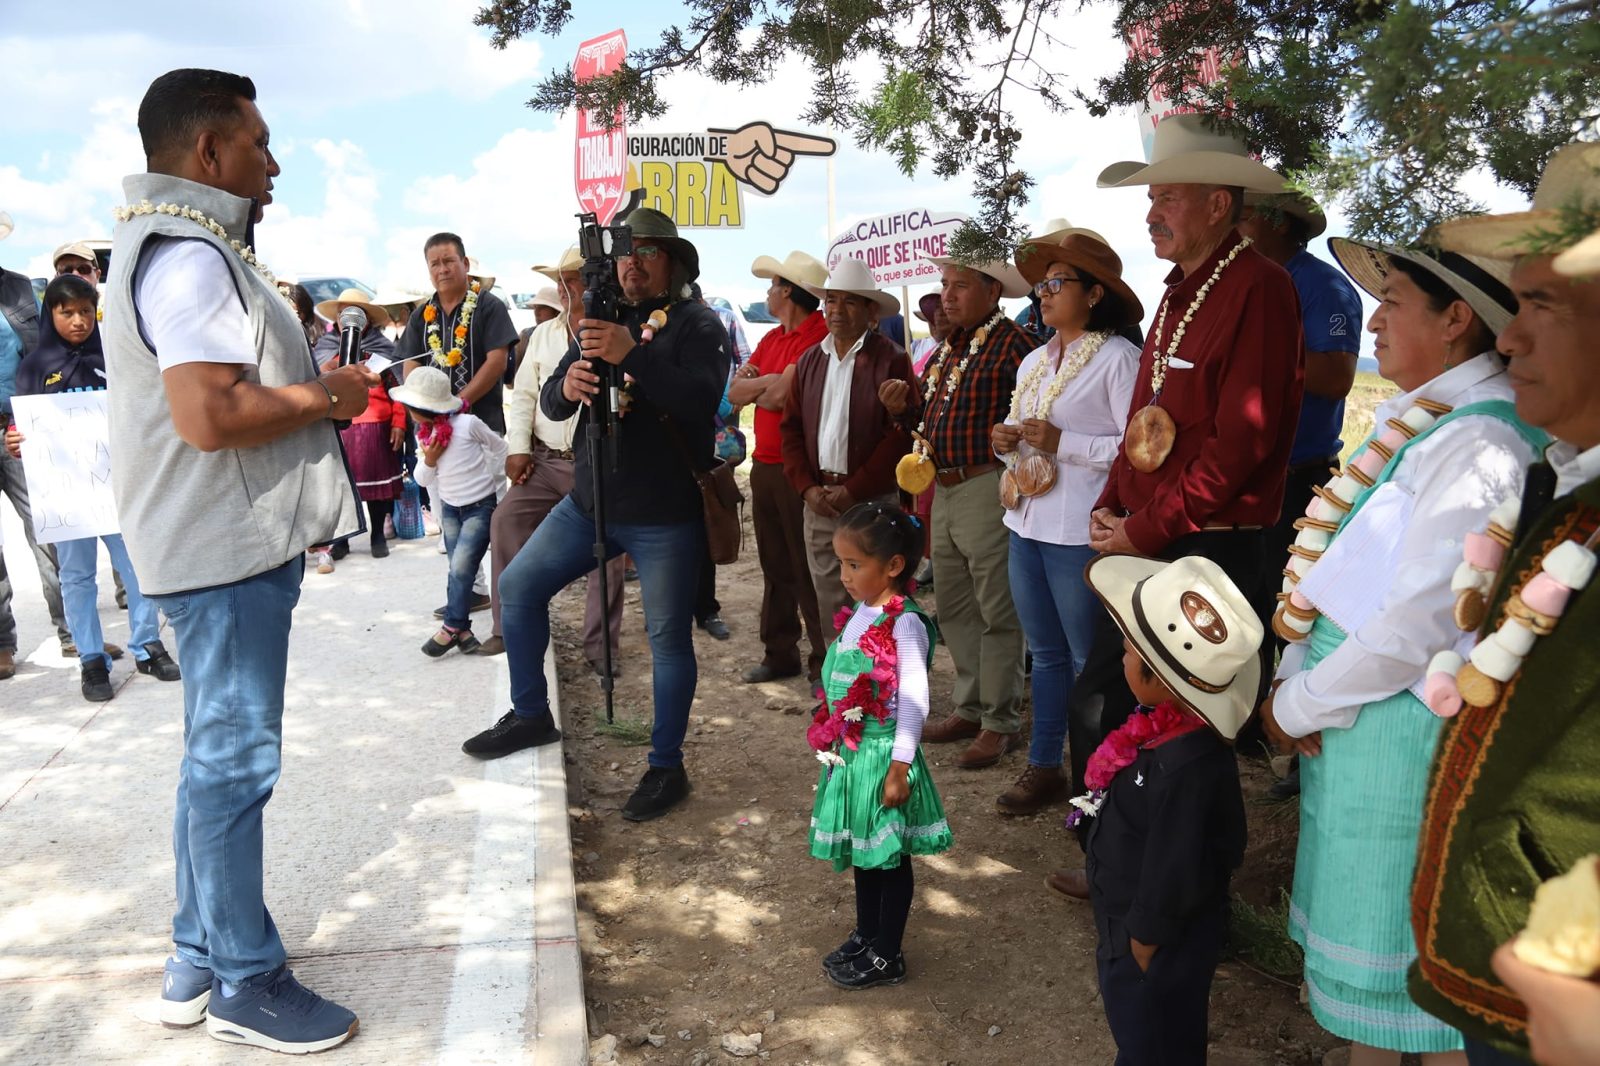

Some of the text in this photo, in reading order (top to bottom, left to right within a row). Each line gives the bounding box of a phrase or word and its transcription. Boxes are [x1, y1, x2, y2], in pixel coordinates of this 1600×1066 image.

[579, 131, 622, 180] TRABAJO
[709, 136, 728, 155] DE
[856, 209, 933, 241] CALIFICA
[867, 245, 891, 269] QUE
[894, 241, 911, 264] SE
[884, 271, 901, 283] que
[903, 268, 913, 279] se
[915, 263, 937, 276] dice.
[1329, 313, 1347, 336] 2
